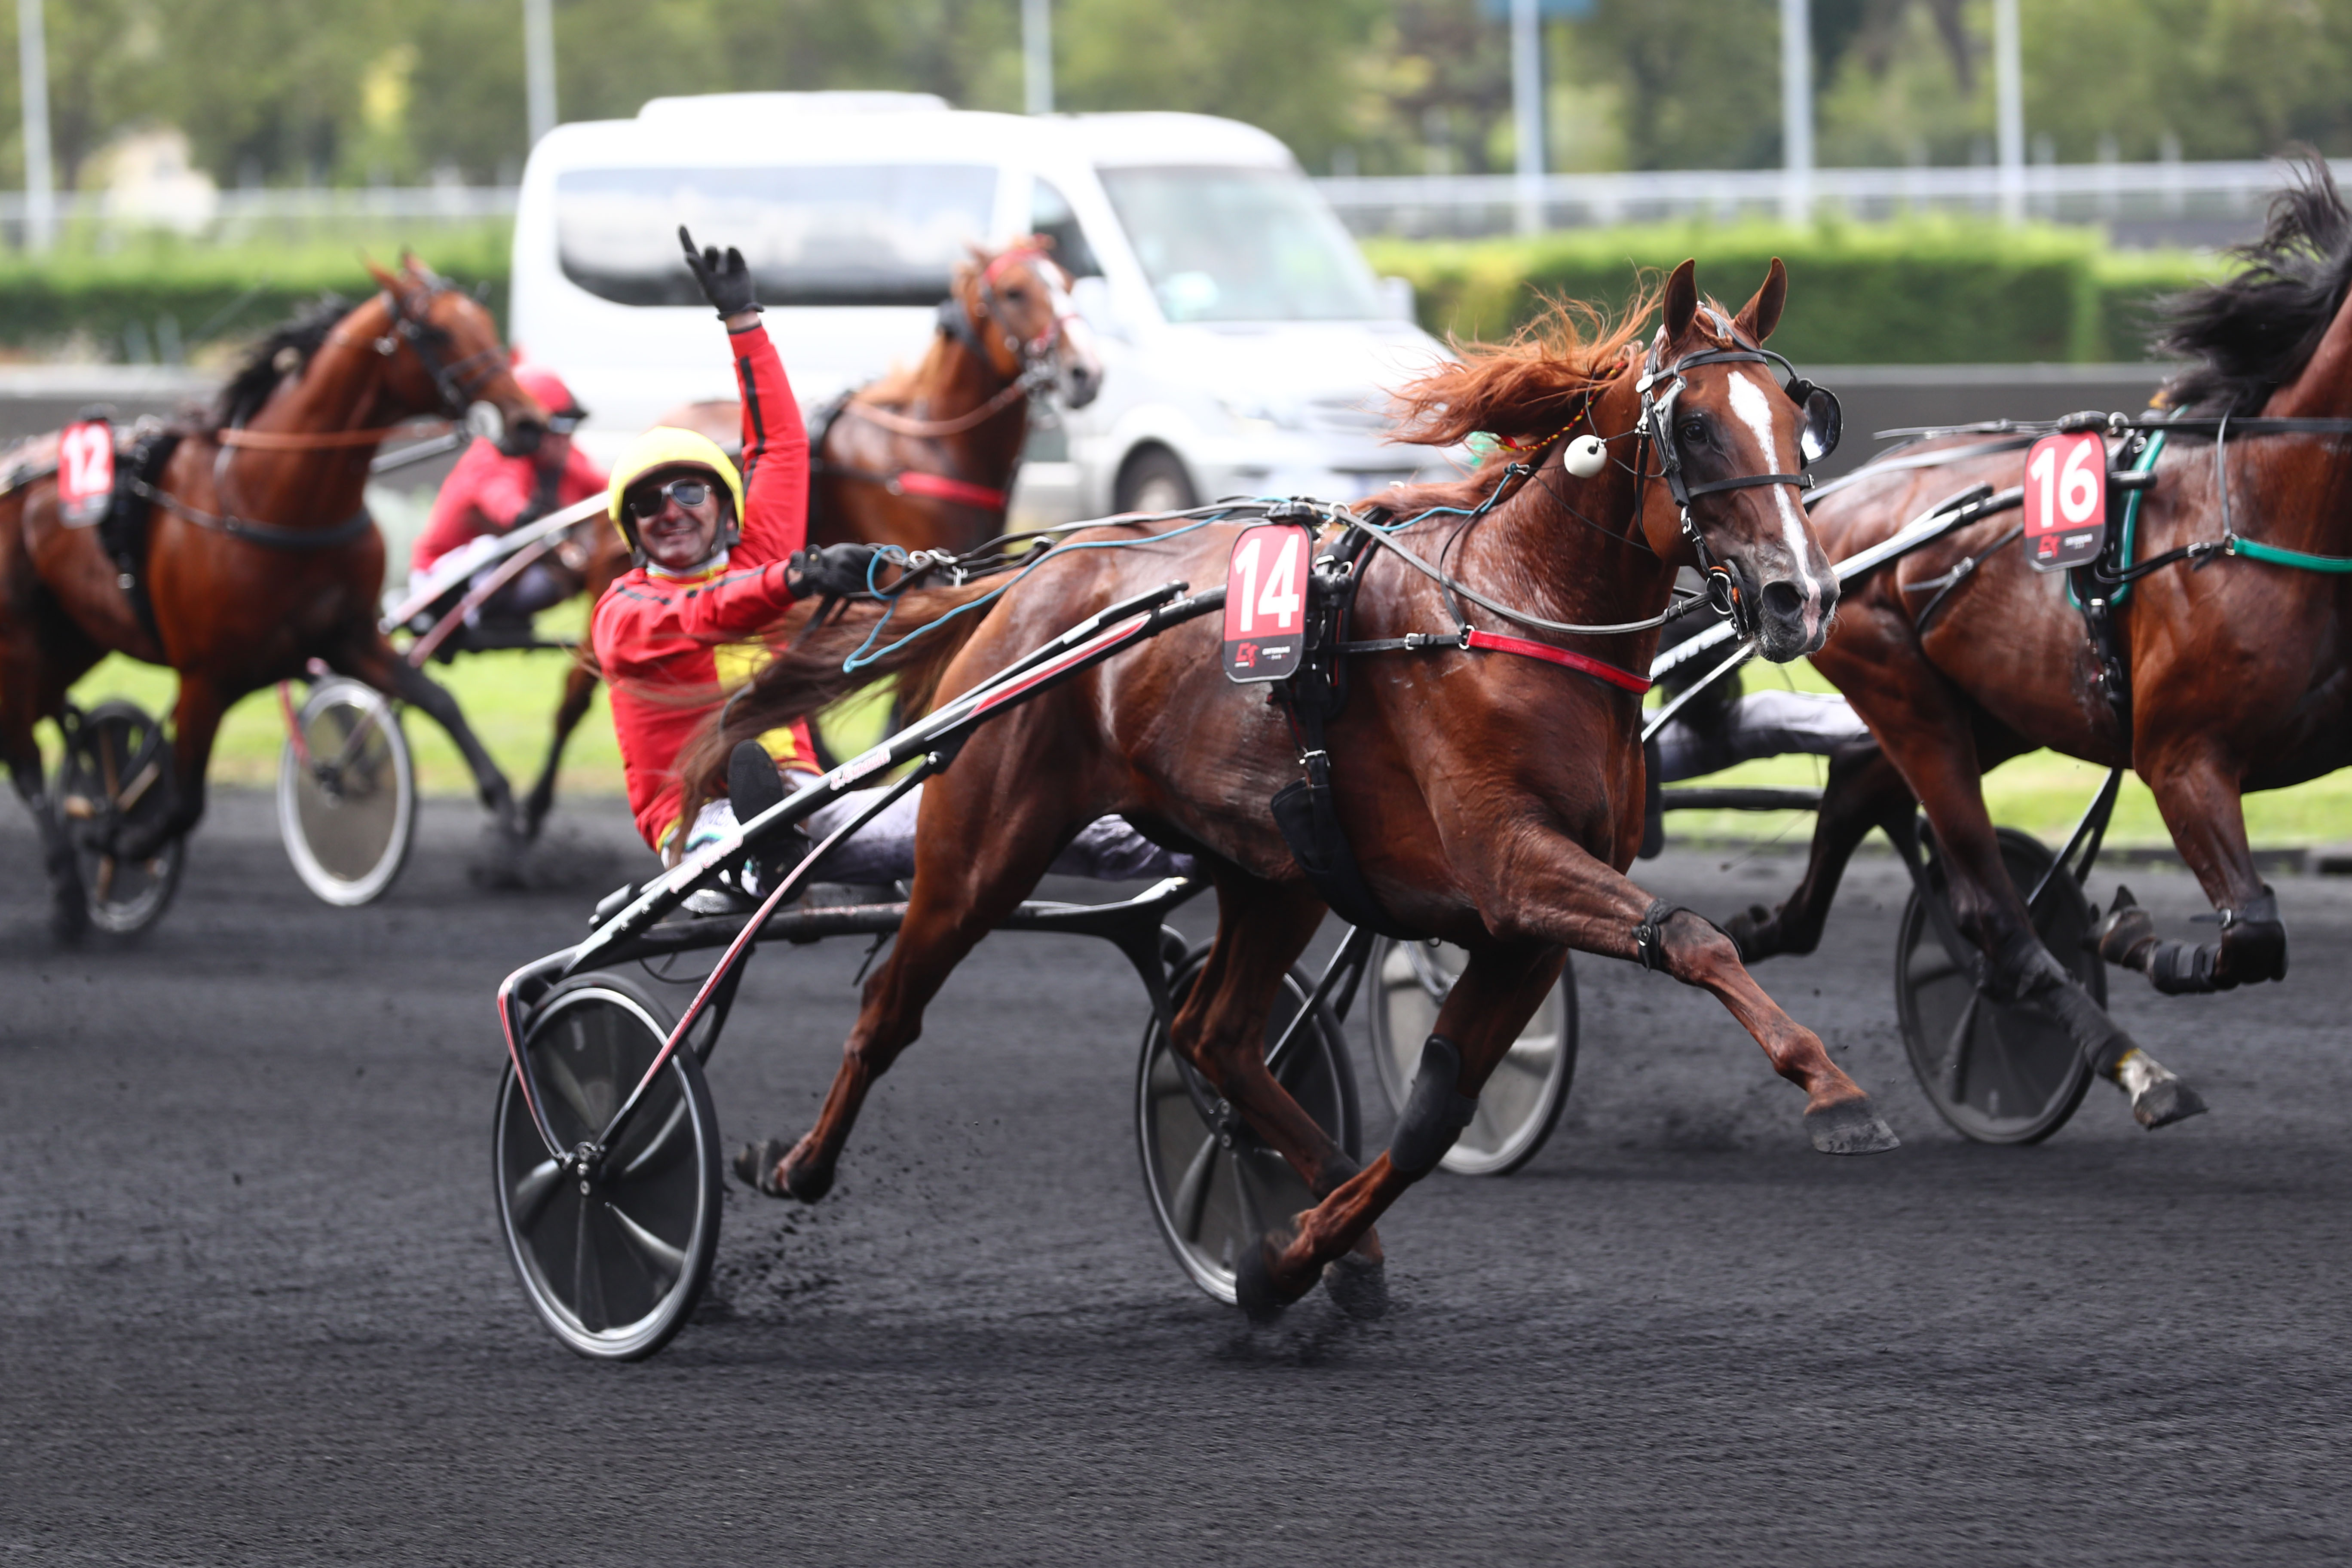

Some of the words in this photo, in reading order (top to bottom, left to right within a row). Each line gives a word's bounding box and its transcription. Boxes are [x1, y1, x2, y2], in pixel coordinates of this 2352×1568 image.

[62, 425, 110, 495] 12
[2030, 438, 2098, 529] 16
[1234, 534, 1300, 632] 14
